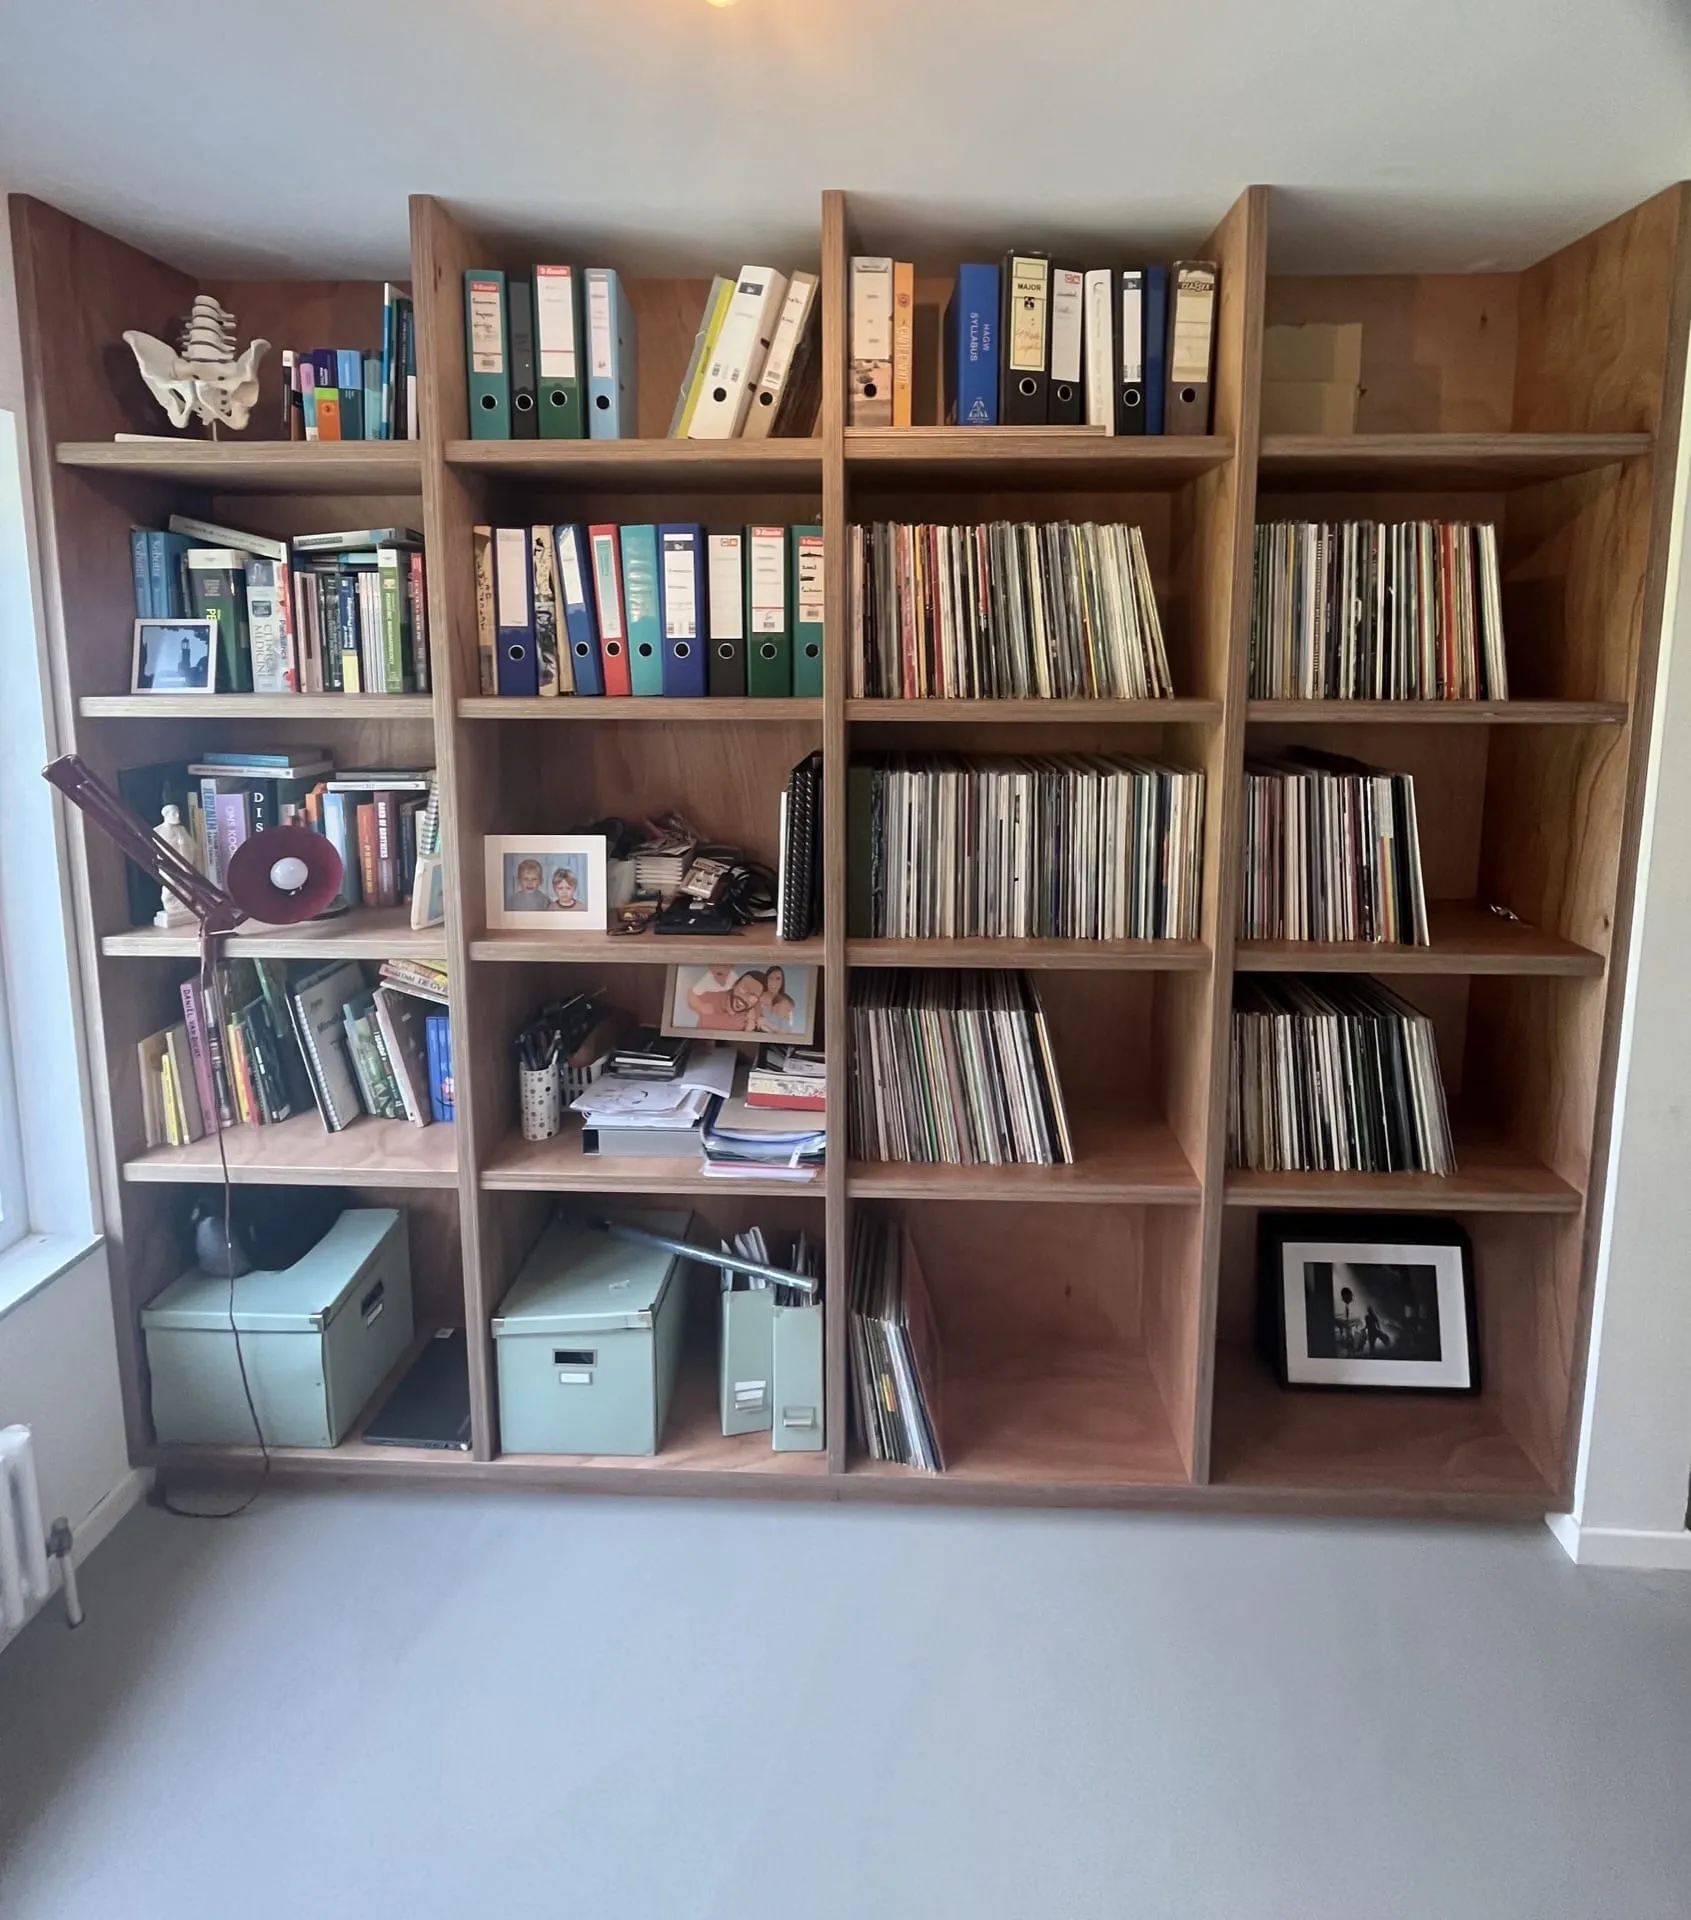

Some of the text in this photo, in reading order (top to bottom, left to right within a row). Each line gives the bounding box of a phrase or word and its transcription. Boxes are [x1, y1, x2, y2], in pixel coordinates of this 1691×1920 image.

[1017, 282, 1042, 291] MAJOR
[969, 312, 980, 362] SYLLABUS
[982, 323, 991, 352] HAGW
[253, 624, 265, 677] MEDICINE
[263, 624, 275, 677] CLINICAL
[225, 805, 238, 858] ONS KOO
[183, 988, 193, 1018] DANIEL
